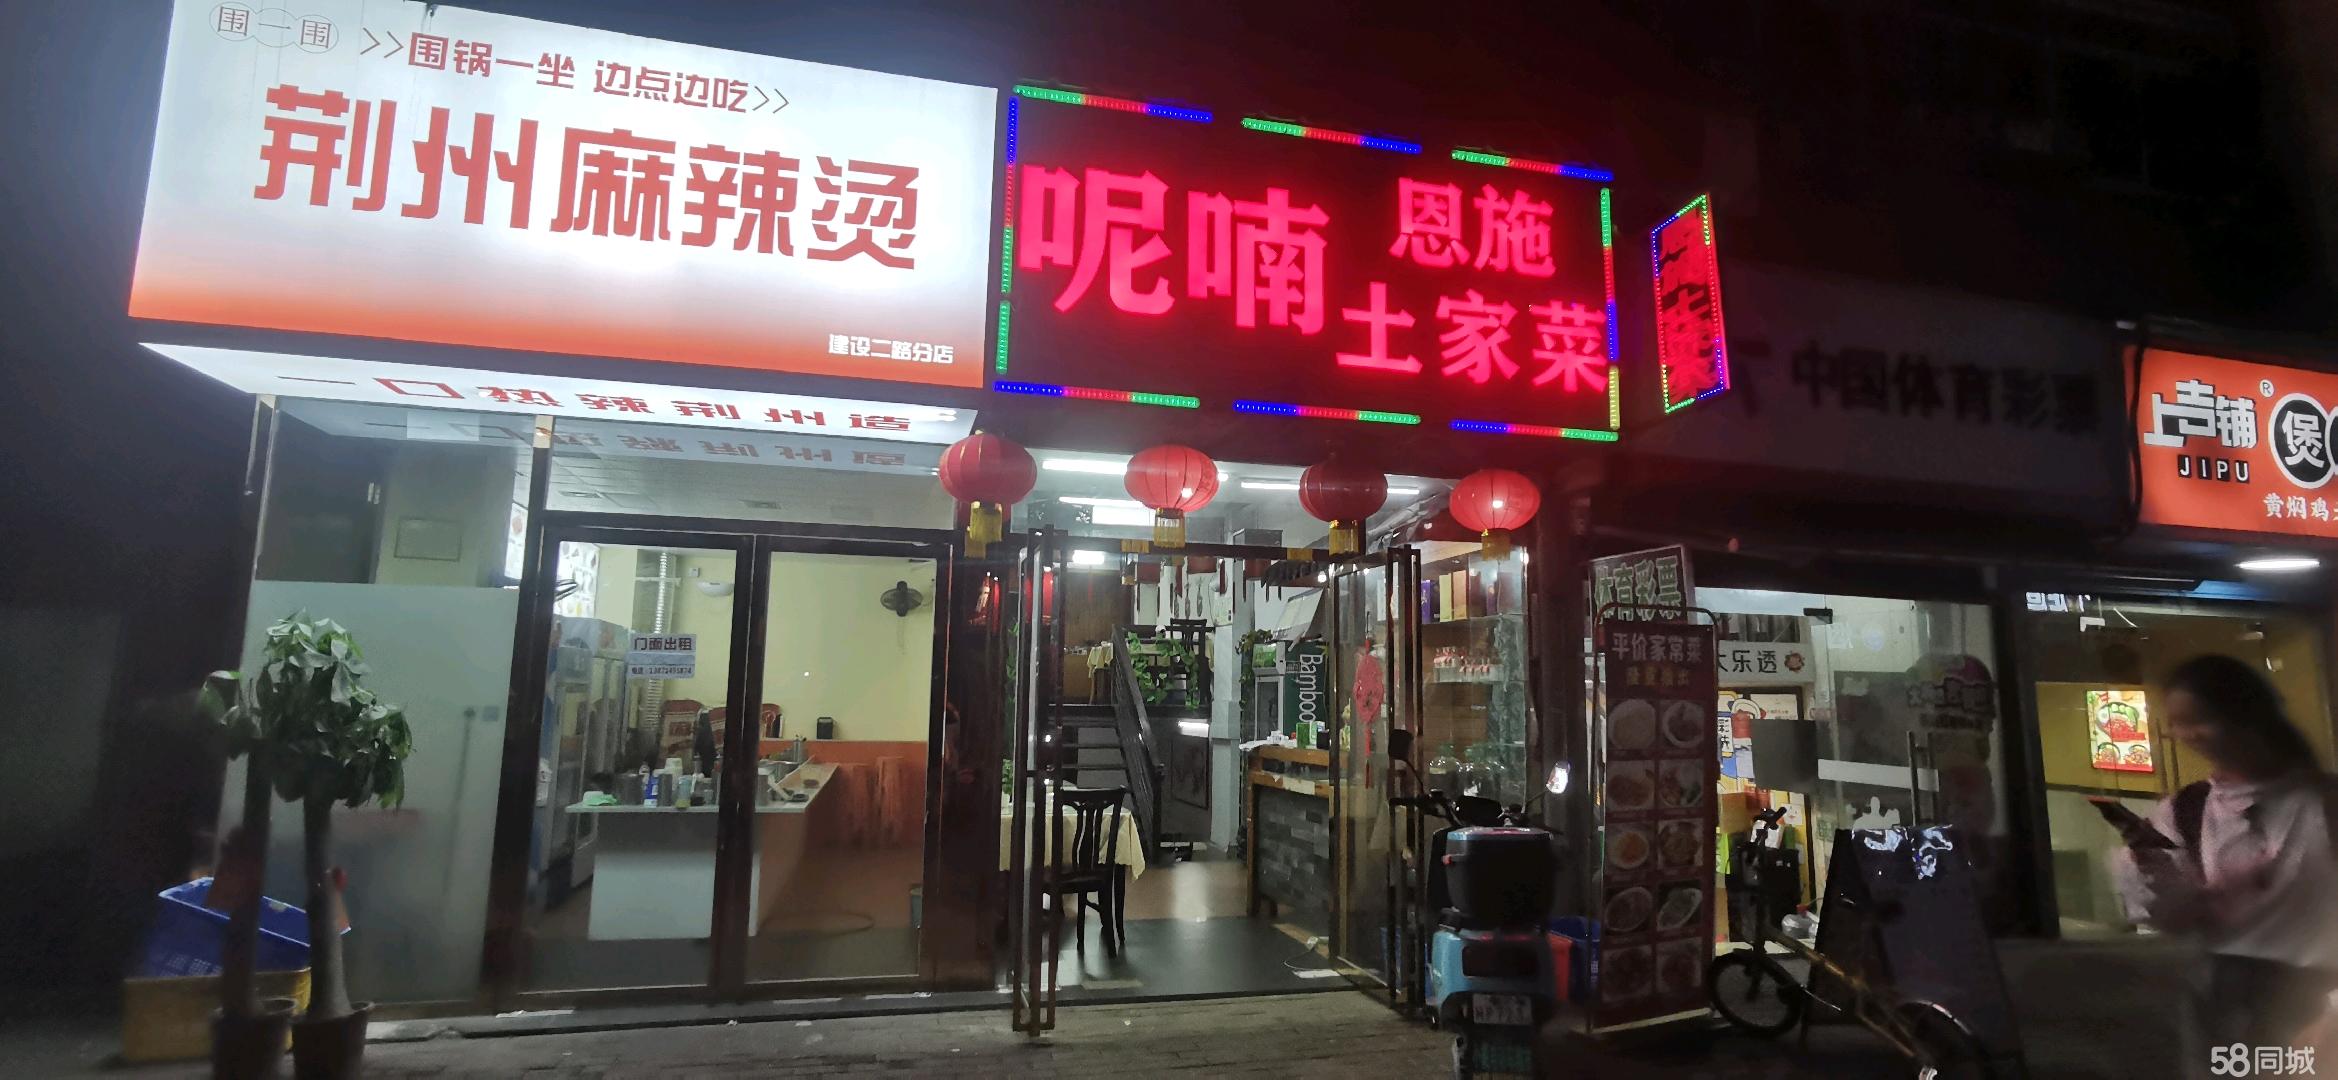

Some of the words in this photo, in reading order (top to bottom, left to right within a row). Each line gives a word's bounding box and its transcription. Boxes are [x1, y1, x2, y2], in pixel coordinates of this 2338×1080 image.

[409, 32, 576, 89] 围锅一坐
[593, 59, 750, 114] 边点边吃
[253, 83, 920, 271] 荆州麻辣烫
[1017, 163, 1331, 337] 呢喃
[1388, 176, 1558, 279] 恩施
[828, 333, 954, 364] 建设二路分店
[1335, 280, 1609, 393] 土家菜
[277, 375, 912, 432] 一口热辣荆州造
[2178, 455, 2250, 483] JIPU
[2281, 410, 2326, 468] 煲
[634, 637, 692, 650] 门面出租
[1611, 632, 1702, 663] 平价家常菜
[1299, 653, 1324, 723] Bamboo
